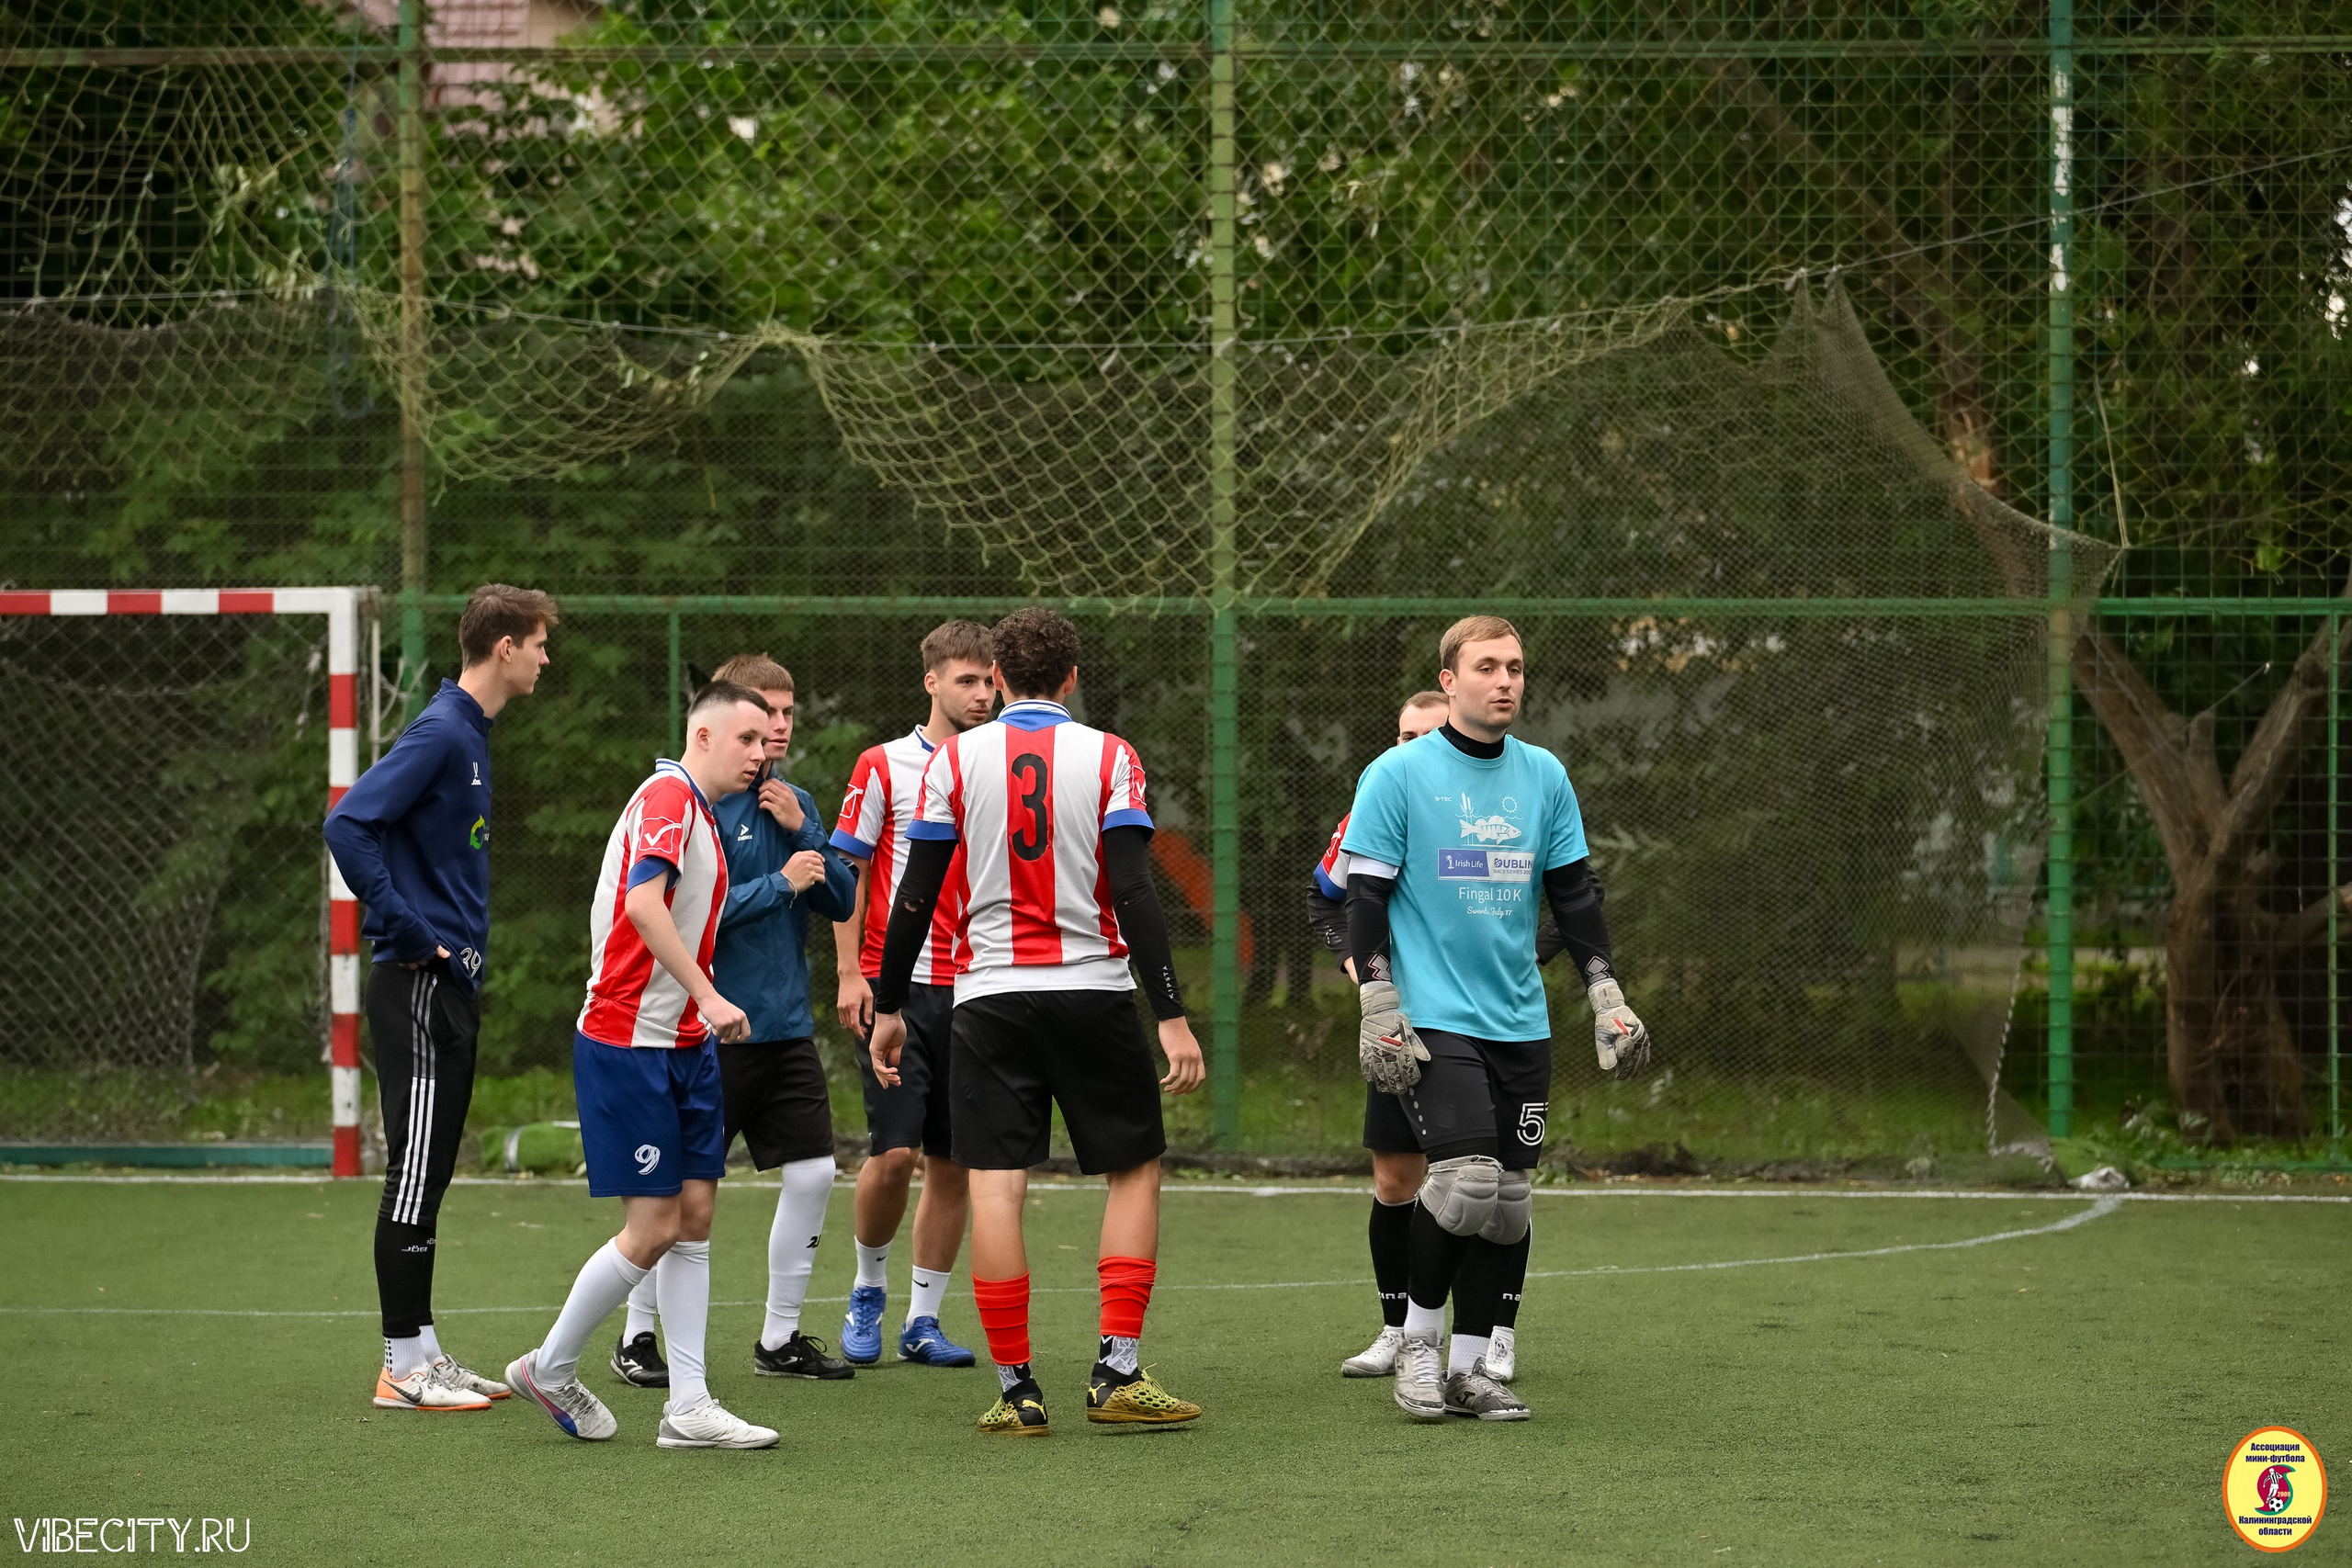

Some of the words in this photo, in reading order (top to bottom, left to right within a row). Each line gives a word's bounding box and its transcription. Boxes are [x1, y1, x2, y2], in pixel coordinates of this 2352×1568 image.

[1012, 752, 1048, 862] 3
[1455, 859, 1471, 868] Irish
[1471, 860, 1484, 869] Life
[1494, 858, 1532, 869] DUBLIN
[1459, 886, 1493, 904] Fingal
[1497, 889, 1511, 902] 10
[1513, 889, 1521, 902] K
[1162, 964, 1174, 999] KIPSTA
[1516, 1101, 1549, 1146] 5
[634, 1144, 661, 1176] 9
